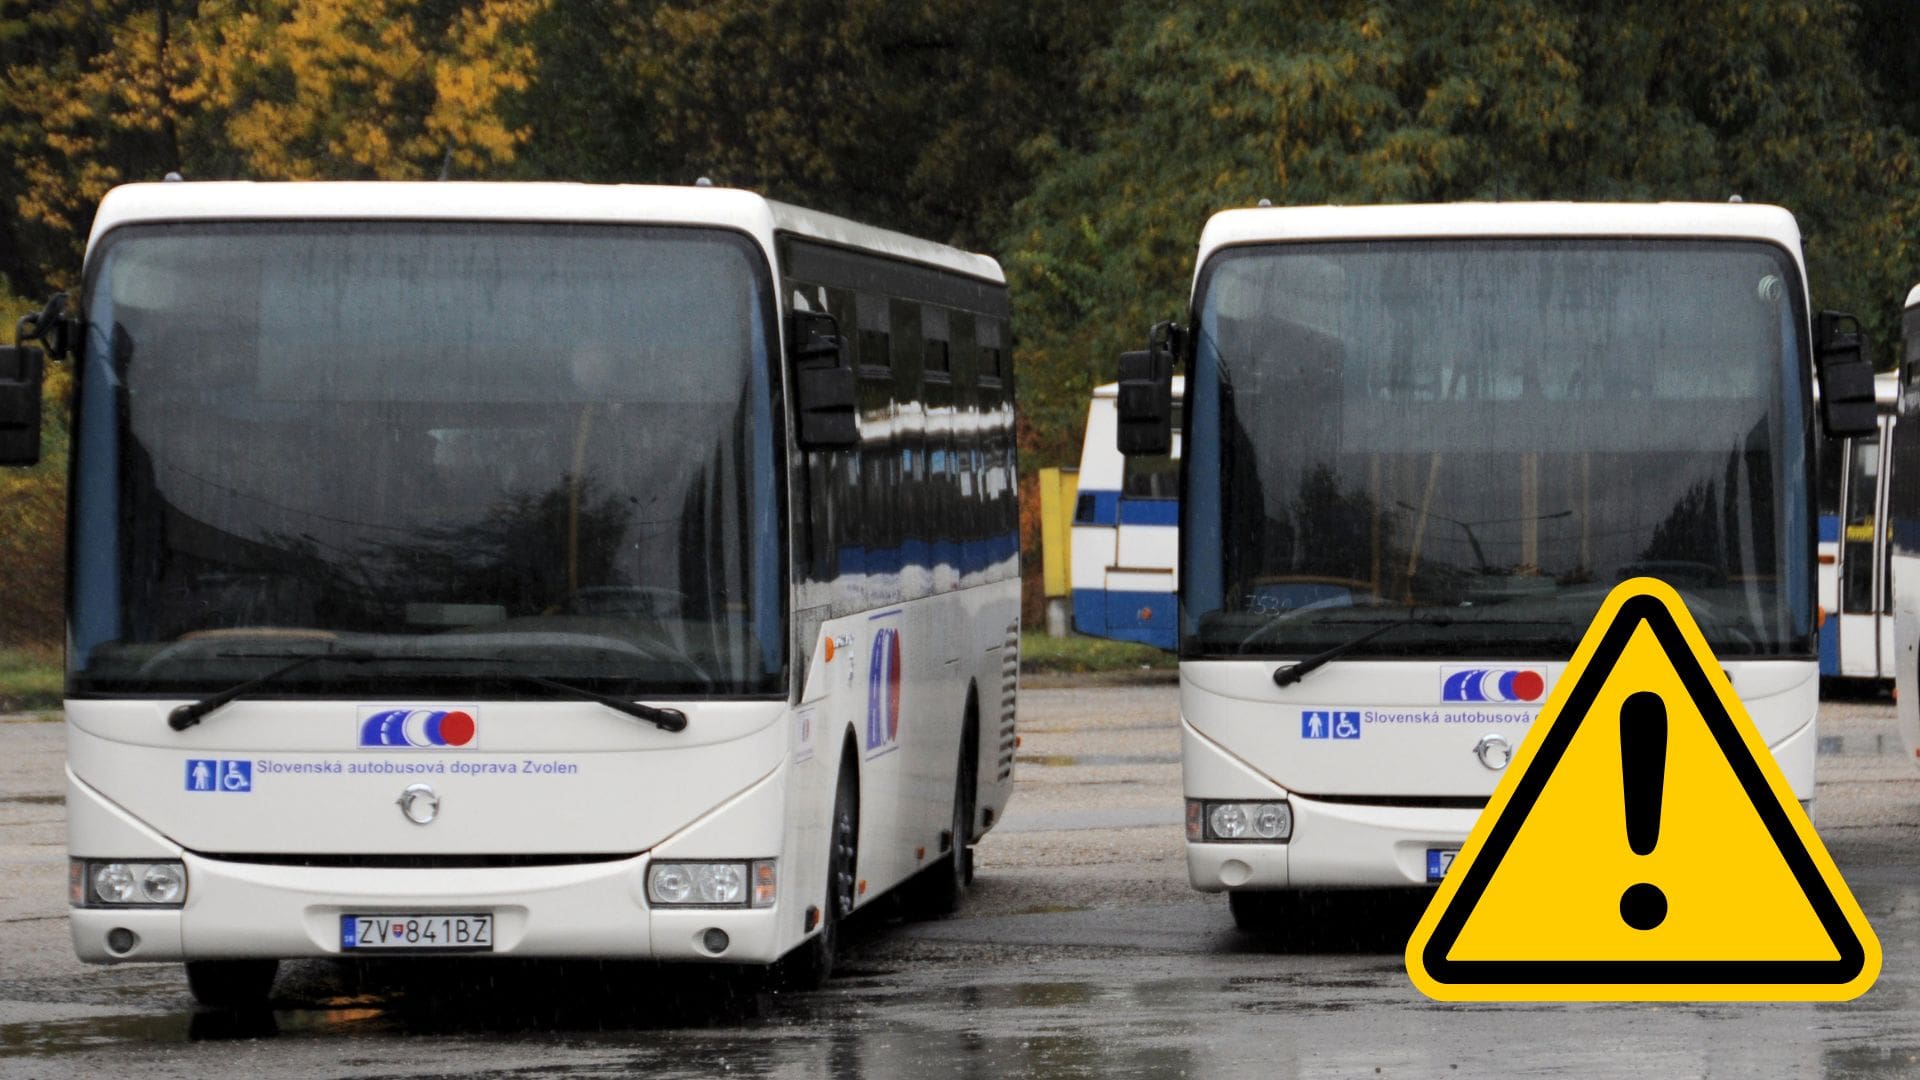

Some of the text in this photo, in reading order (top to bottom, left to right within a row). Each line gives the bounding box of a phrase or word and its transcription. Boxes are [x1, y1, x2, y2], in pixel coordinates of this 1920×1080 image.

[1364, 710, 1440, 724] Slovenská
[1444, 710, 1530, 724] autobusová
[256, 759, 578, 777] Slovenská autobusová doprava Zvolen
[359, 919, 488, 944] ZV 841BZ
